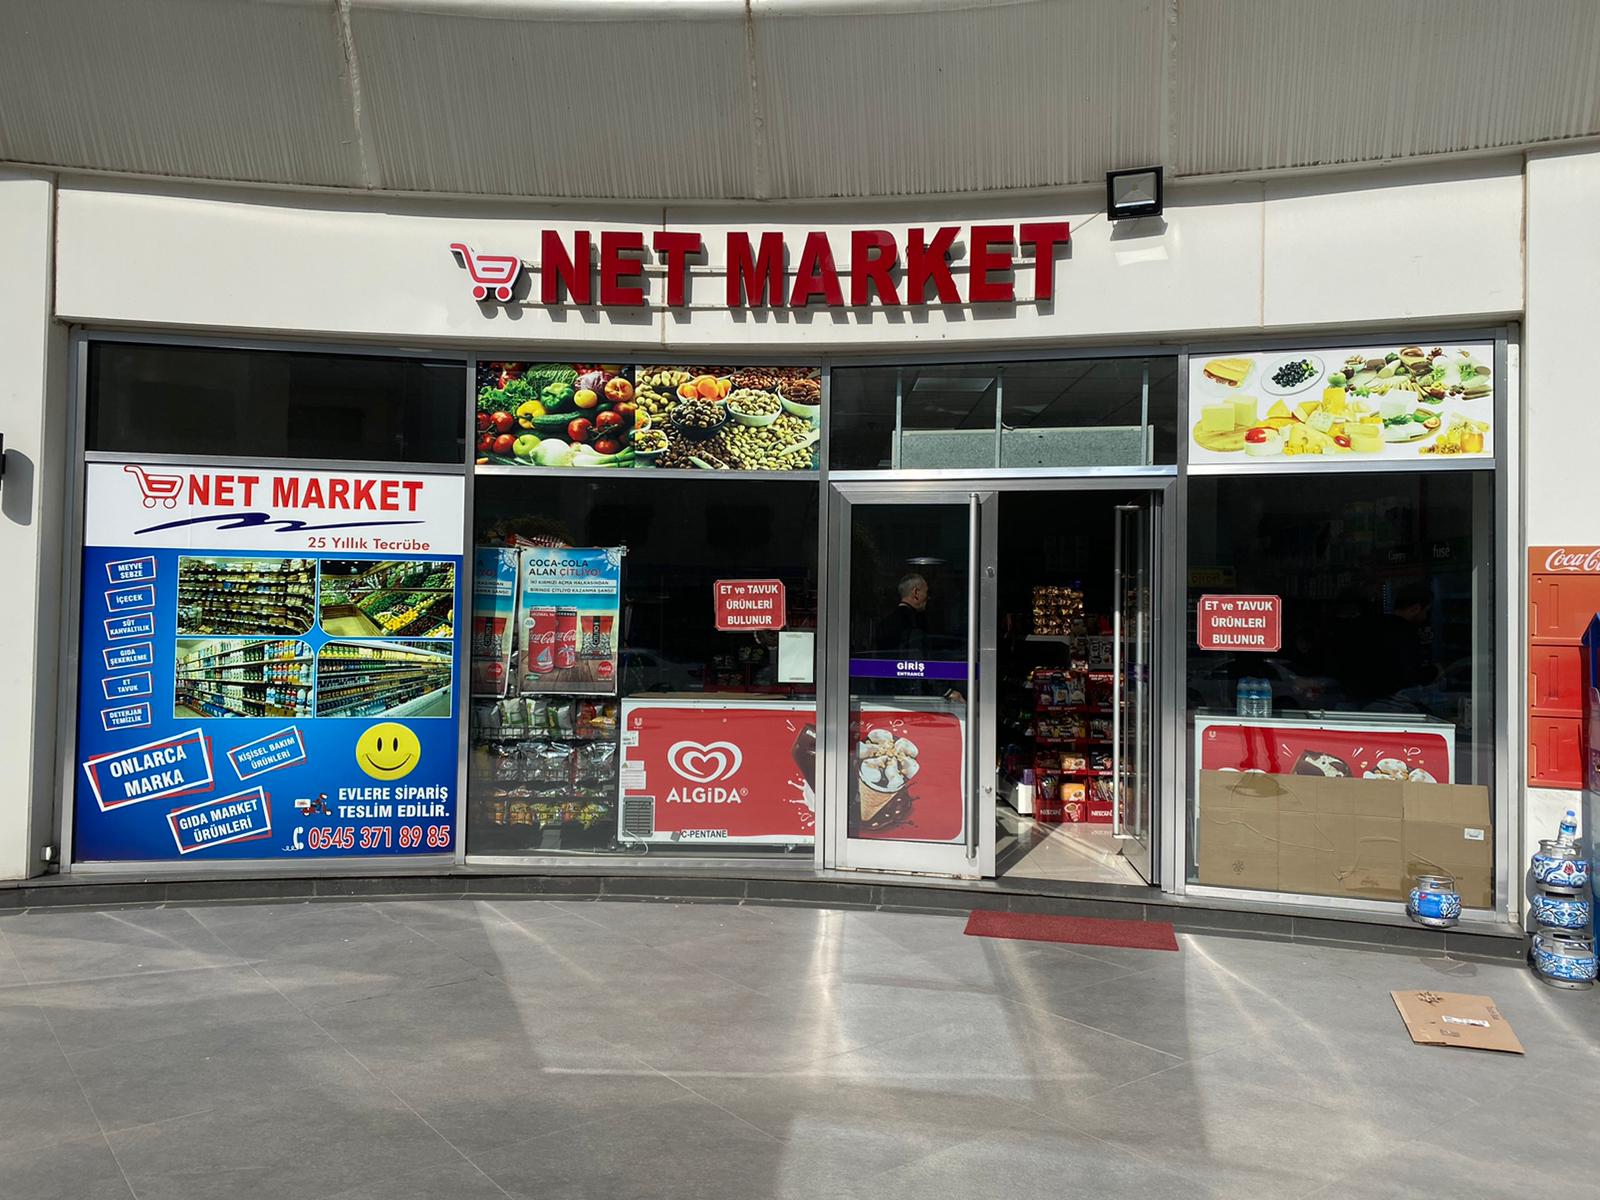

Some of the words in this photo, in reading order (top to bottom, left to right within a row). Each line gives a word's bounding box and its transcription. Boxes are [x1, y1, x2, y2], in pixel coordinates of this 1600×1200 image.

[541, 230, 701, 306] NET
[726, 222, 1070, 307] MARKET
[188, 474, 260, 507] NET
[272, 477, 424, 511] MARKET
[308, 537, 326, 549] 25
[332, 537, 368, 550] Yıllık
[373, 538, 430, 551] Tecrübe
[118, 563, 143, 571] MEYVE
[529, 559, 589, 567] COCA-COLA
[120, 570, 143, 579] SEBZE
[529, 568, 557, 576] ALAN
[720, 585, 732, 594] ET
[747, 585, 778, 593] TAVUK
[116, 594, 143, 604] İÇECEK
[726, 598, 773, 609] ÜRÜNLERİ
[1205, 601, 1219, 610] ET
[1236, 601, 1273, 611] TAVUK
[122, 619, 135, 627] SÜT
[727, 615, 772, 625] BULUNUR
[1211, 616, 1266, 628] ÜRÜNLERİ
[110, 625, 150, 635] KAHVALTILIK
[1212, 634, 1264, 644] BULUNUR
[896, 661, 925, 672] GİRİŞ
[117, 685, 138, 693] TAVUK
[109, 708, 142, 718] DETERJAN
[238, 746, 269, 763] KİŞİSEL
[269, 736, 295, 752] BAKIM
[109, 745, 187, 778] ONLARCA
[250, 749, 291, 770] ÜRÜNLERİ
[124, 769, 185, 797] MARKA
[338, 788, 391, 800] EVLERE
[395, 784, 448, 802] SİPARİŞ
[179, 814, 209, 830] GIDA
[210, 799, 258, 822] MARKET
[338, 802, 392, 818] TESLİM
[397, 801, 450, 817] EDİLİR.
[193, 815, 253, 843] ÜRÜNLERİ
[681, 830, 727, 838] C-PENTANE
[308, 826, 355, 849] 0545
[359, 825, 392, 848] 371
[399, 825, 423, 847] 89
[427, 824, 450, 847] 85
